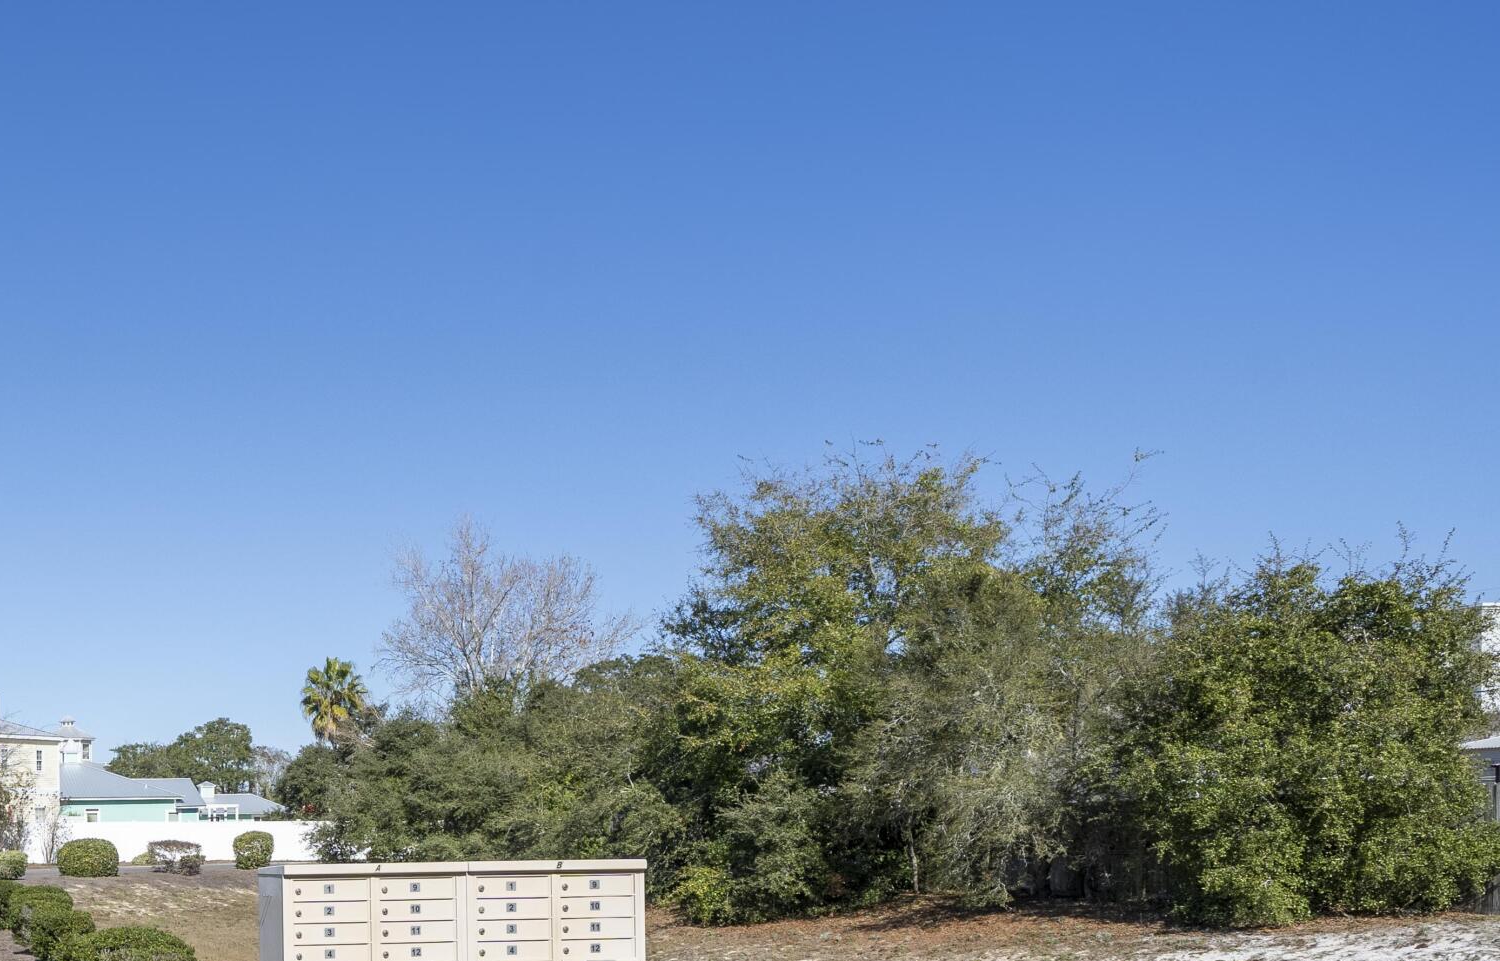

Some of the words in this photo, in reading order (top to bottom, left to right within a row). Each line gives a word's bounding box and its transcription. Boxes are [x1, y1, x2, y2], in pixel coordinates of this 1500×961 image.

[411, 905, 420, 913] 10
[590, 902, 600, 910] 10
[411, 927, 420, 935] 11
[591, 923, 600, 931] 11
[412, 948, 421, 956] 12
[591, 944, 600, 952] 12
